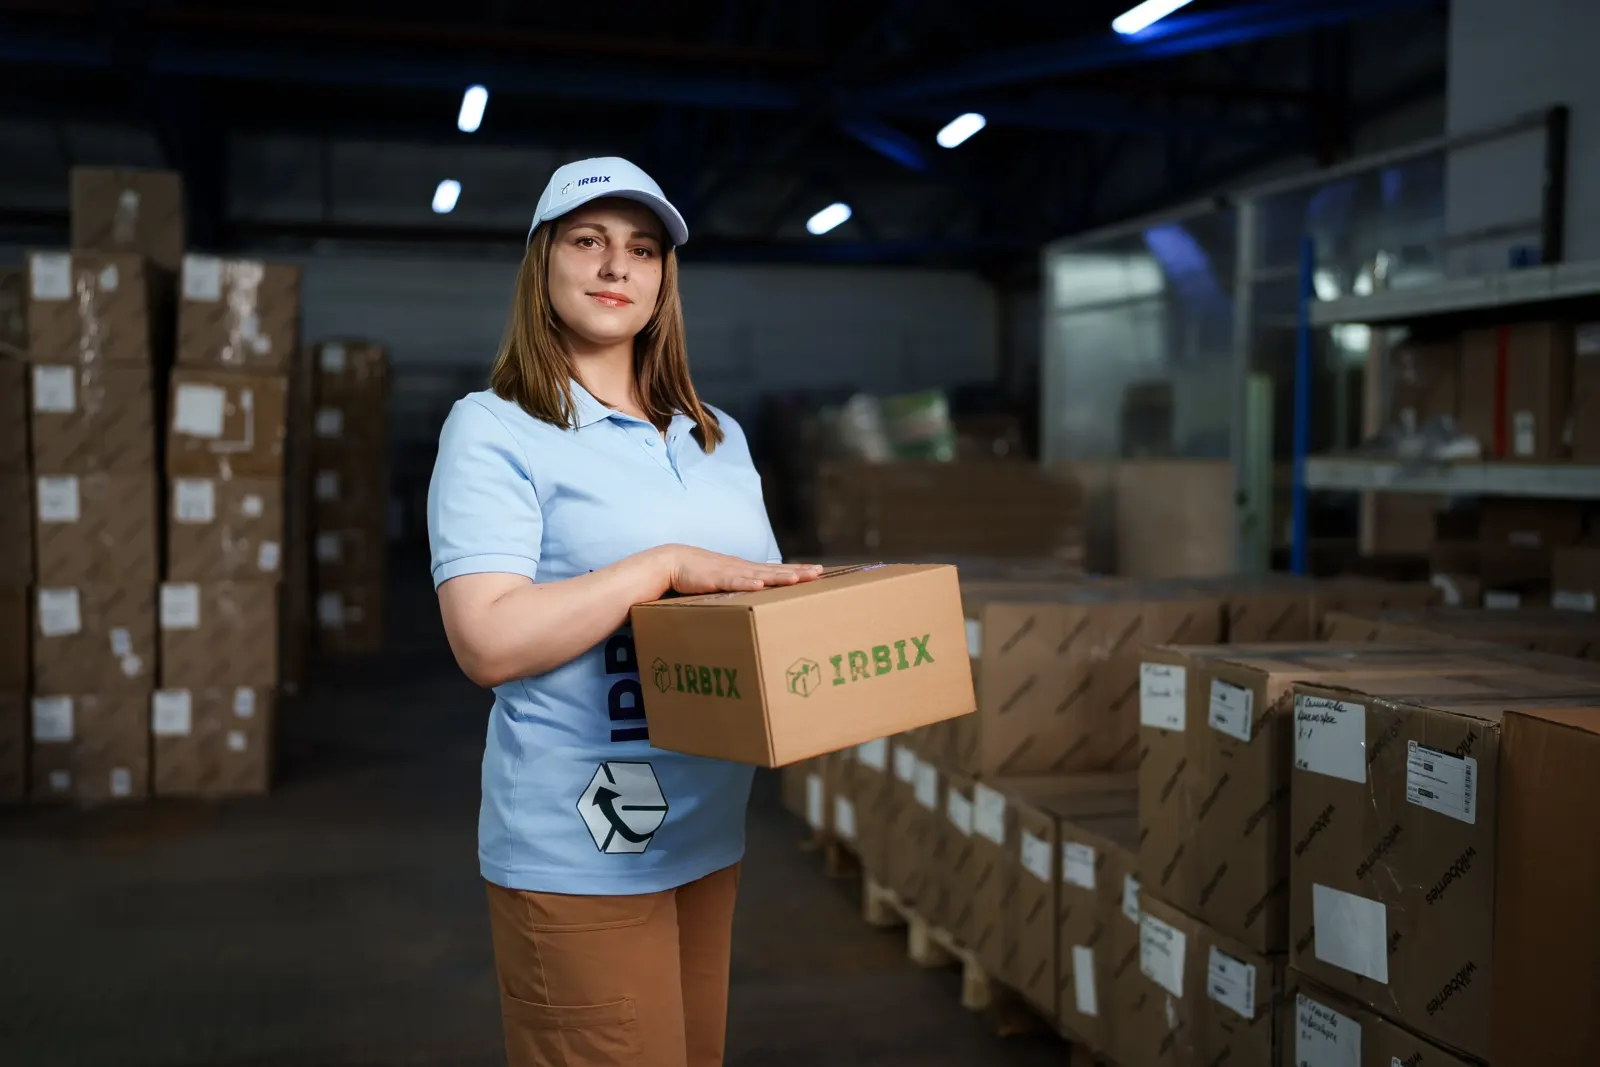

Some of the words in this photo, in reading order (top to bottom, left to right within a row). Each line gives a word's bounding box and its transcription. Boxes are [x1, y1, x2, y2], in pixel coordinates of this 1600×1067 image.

[578, 176, 611, 187] IRBIX
[674, 663, 741, 699] IRBIX
[829, 634, 935, 686] IRBIX
[1426, 846, 1476, 905] wildberries
[1426, 960, 1477, 1016] wildberries
